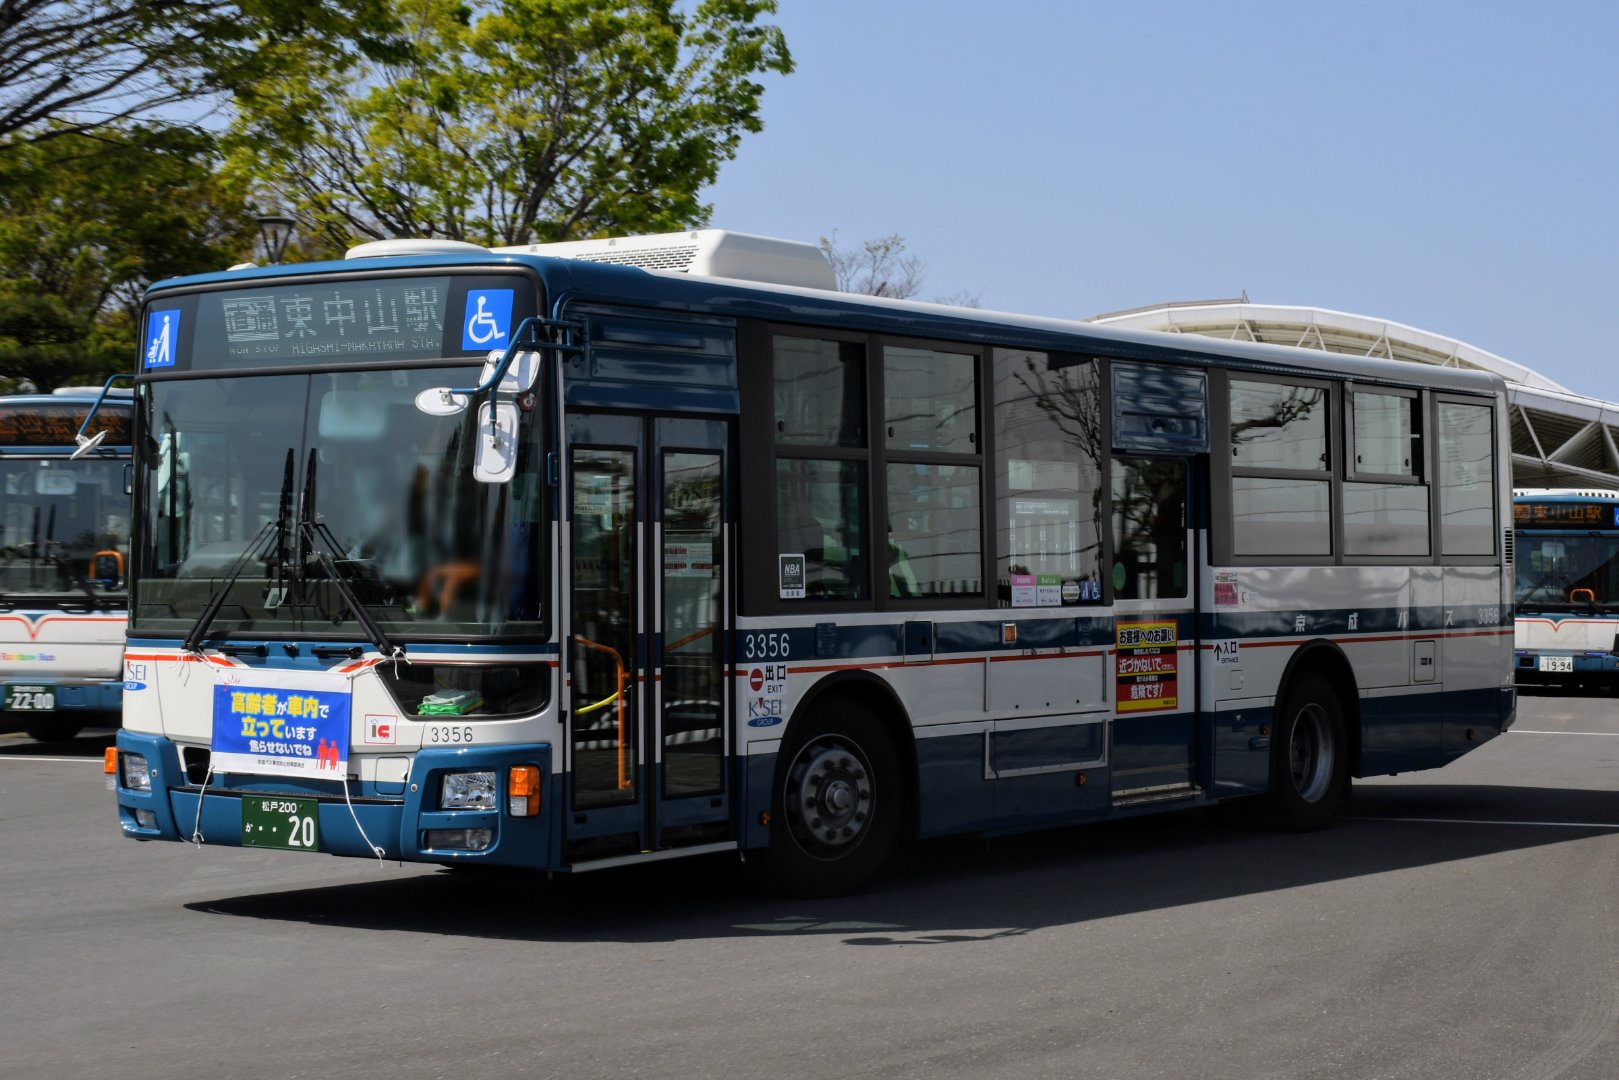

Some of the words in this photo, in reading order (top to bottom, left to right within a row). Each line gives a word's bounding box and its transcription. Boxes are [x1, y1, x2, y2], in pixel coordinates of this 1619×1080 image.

[281, 287, 442, 338] 東中山駅
[784, 563, 800, 575] NBA
[1478, 607, 1499, 624] 3356
[1119, 628, 1174, 645] お客様へのお願い
[745, 633, 790, 659] 3356
[1223, 641, 1237, 654] 入口
[765, 664, 786, 682] 出口
[767, 684, 783, 693] EXIT
[230, 692, 330, 719] 高齢者が車内で
[240, 716, 317, 741] 立っています
[756, 717, 774, 727] GROUP
[431, 726, 473, 743] 3356
[249, 739, 313, 757] 焦らせないでね
[261, 800, 298, 814] 松戸200
[288, 815, 315, 847] 20
